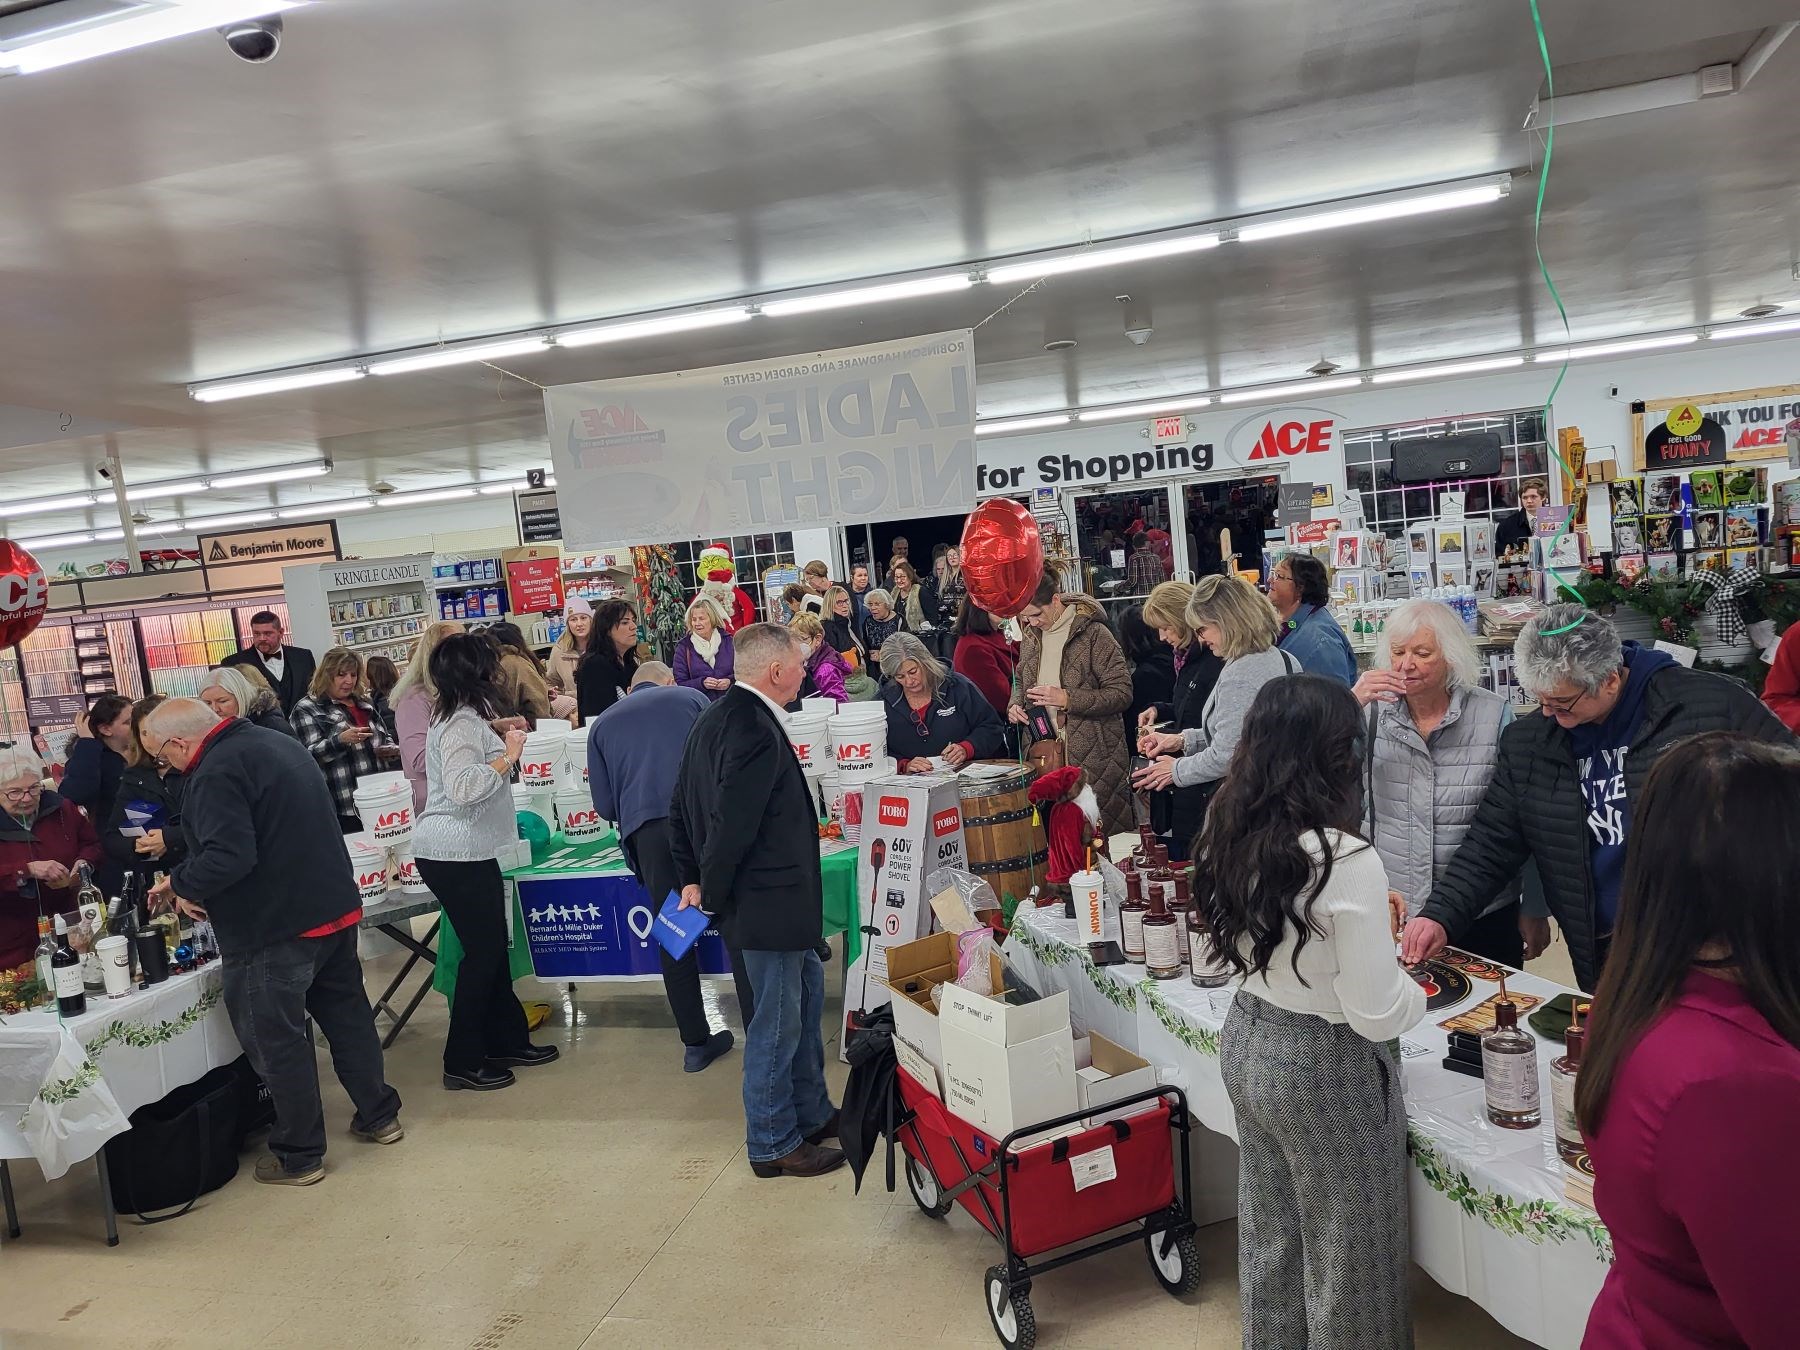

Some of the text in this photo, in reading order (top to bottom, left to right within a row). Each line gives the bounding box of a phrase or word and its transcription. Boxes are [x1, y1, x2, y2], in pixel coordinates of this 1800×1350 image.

[1738, 405, 1774, 424] YOU
[1778, 401, 1800, 420] FO
[1156, 416, 1181, 438] EXIT
[1248, 419, 1334, 461] ACE
[1684, 434, 1702, 442] GOOD
[1733, 427, 1784, 449] ACE
[1660, 440, 1712, 460] FUNNY
[977, 443, 1214, 490] for Shopping
[532, 472, 541, 485] 2
[1614, 520, 1637, 528] DANG!
[230, 535, 324, 560] Benjamin Moore
[334, 564, 419, 586] KRINGLE CANDLE
[0, 571, 48, 611] CE
[836, 743, 872, 761] ACE
[837, 761, 874, 771] Hardware
[374, 808, 410, 831] ACE
[565, 810, 599, 828] ACE
[881, 805, 906, 818] TORO
[936, 816, 958, 830] TORO
[374, 825, 413, 840] Hardware
[564, 826, 601, 838] Hardware
[892, 838, 912, 854] 60V
[938, 842, 959, 860] 60V
[889, 861, 912, 872] POWER
[890, 854, 912, 862] CORDLESS
[888, 871, 911, 882] SHOVEL
[1088, 891, 1101, 936] DUNKIN'
[529, 922, 604, 934] Bernard & Millie Duker
[531, 932, 593, 943] Children's Hospital
[534, 946, 557, 954] ALBANY
[558, 945, 572, 953] MED
[589, 945, 608, 953] System
[953, 1001, 965, 1012] STOP
[983, 1014, 993, 1024] LIFT
